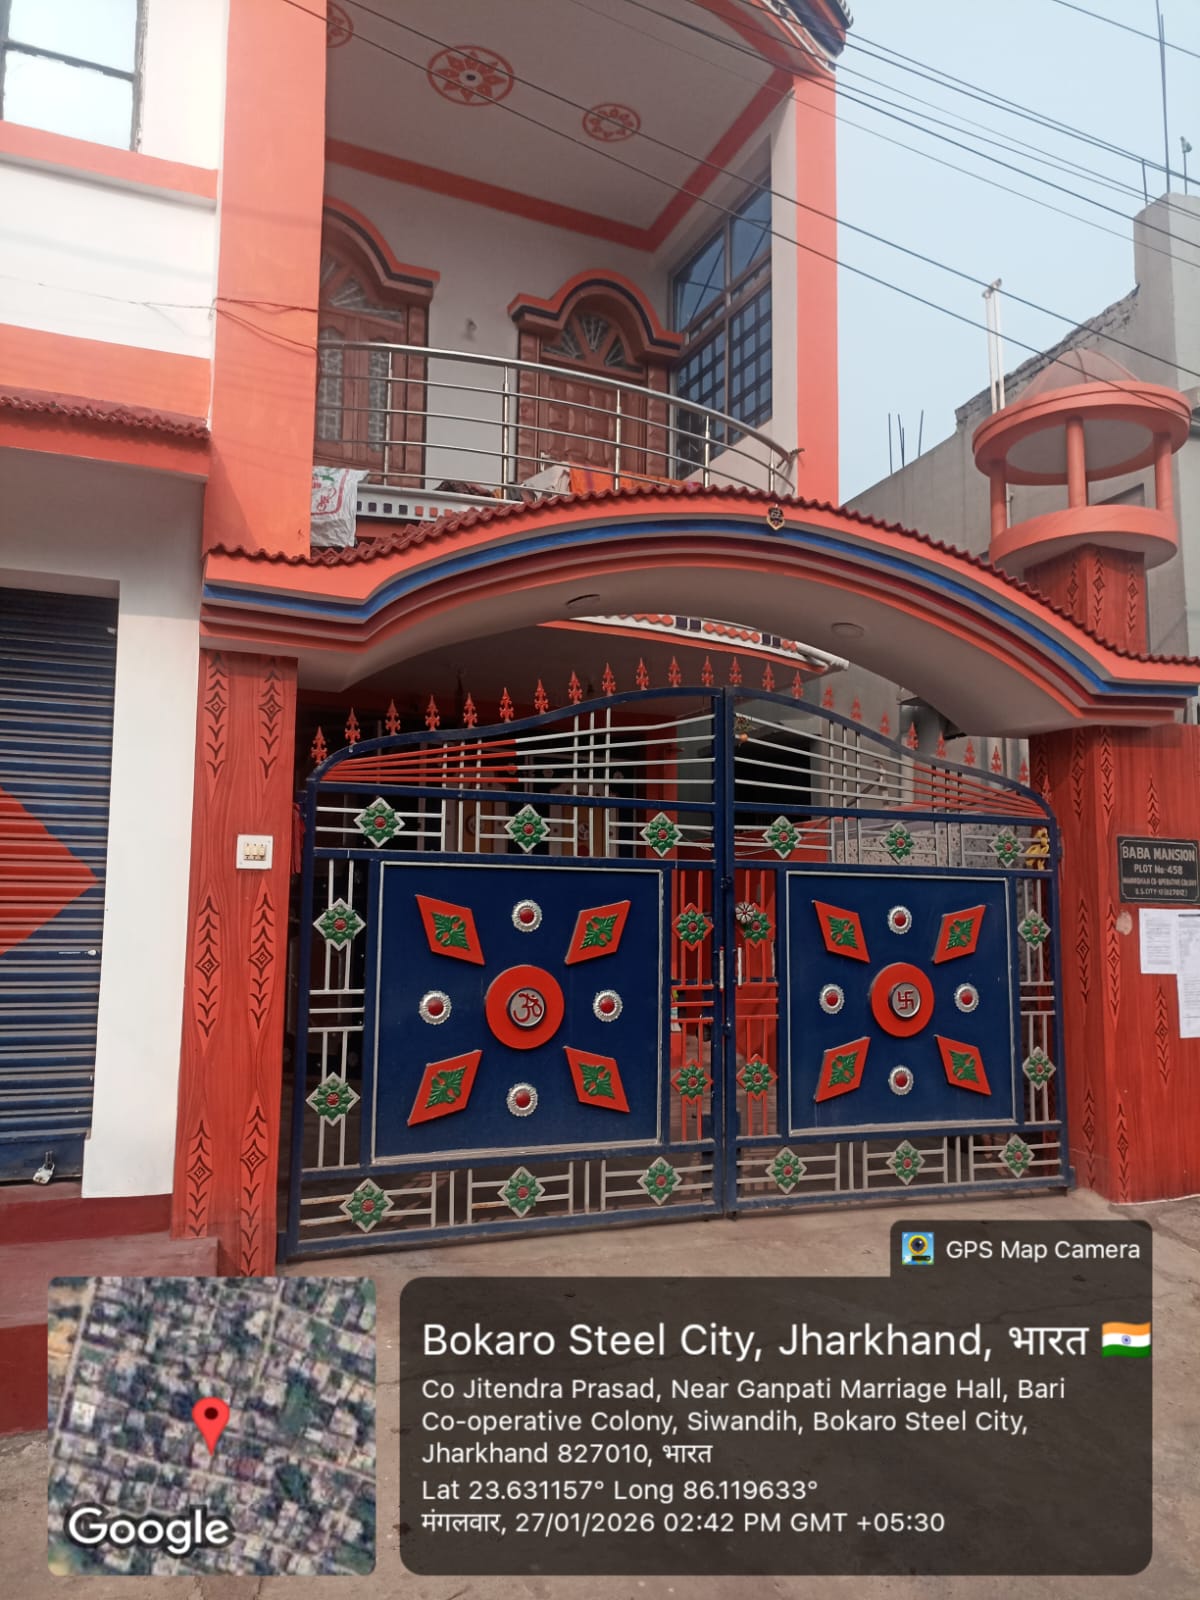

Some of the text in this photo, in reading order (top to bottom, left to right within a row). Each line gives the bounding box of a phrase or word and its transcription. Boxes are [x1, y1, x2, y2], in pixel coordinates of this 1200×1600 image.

[1122, 846, 1195, 861] BABA MANSION
[1134, 864, 1152, 873] PLOT
